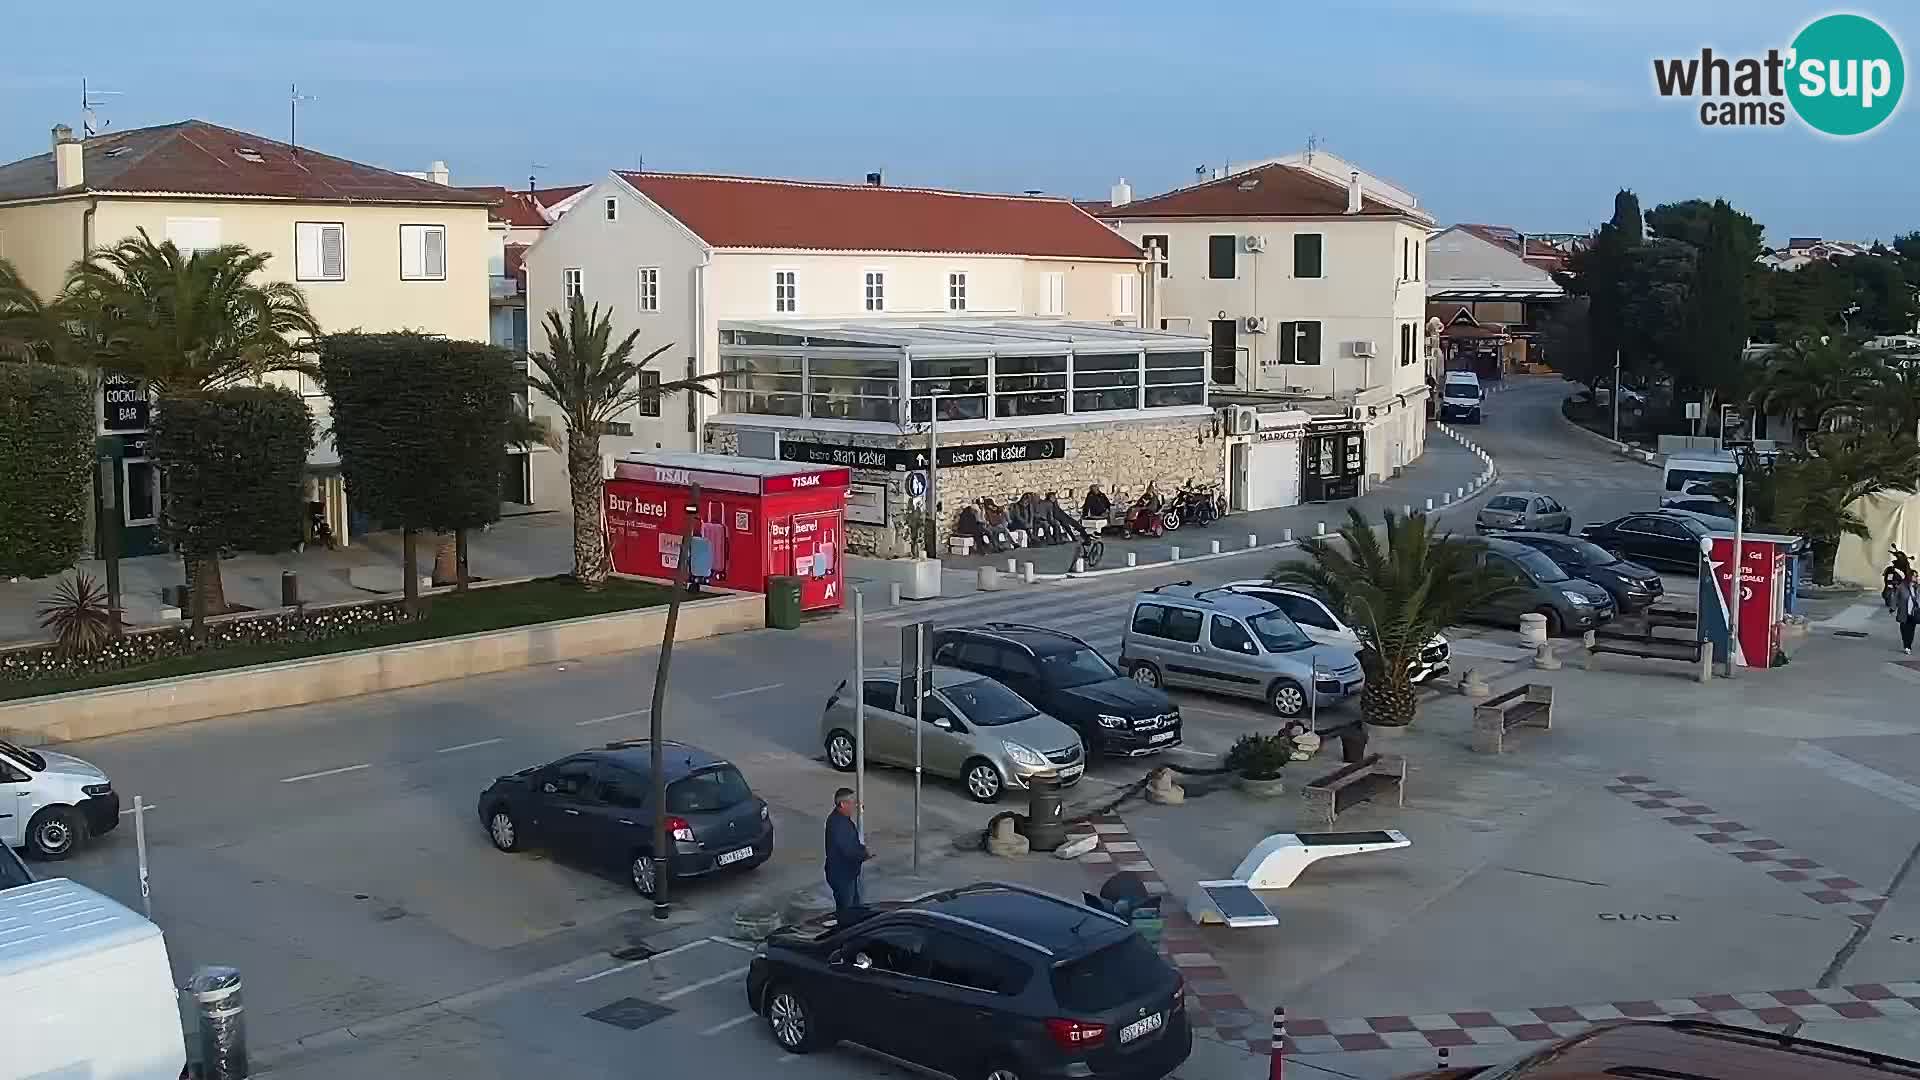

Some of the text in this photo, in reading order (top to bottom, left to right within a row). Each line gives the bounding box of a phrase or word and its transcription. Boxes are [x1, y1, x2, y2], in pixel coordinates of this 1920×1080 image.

[119, 407, 137, 421] BAR
[952, 452, 974, 463] bistro
[656, 469, 691, 485] TISAK
[791, 475, 820, 488] TISAK
[608, 493, 668, 519] Buy here!
[772, 519, 818, 537] Buy here!
